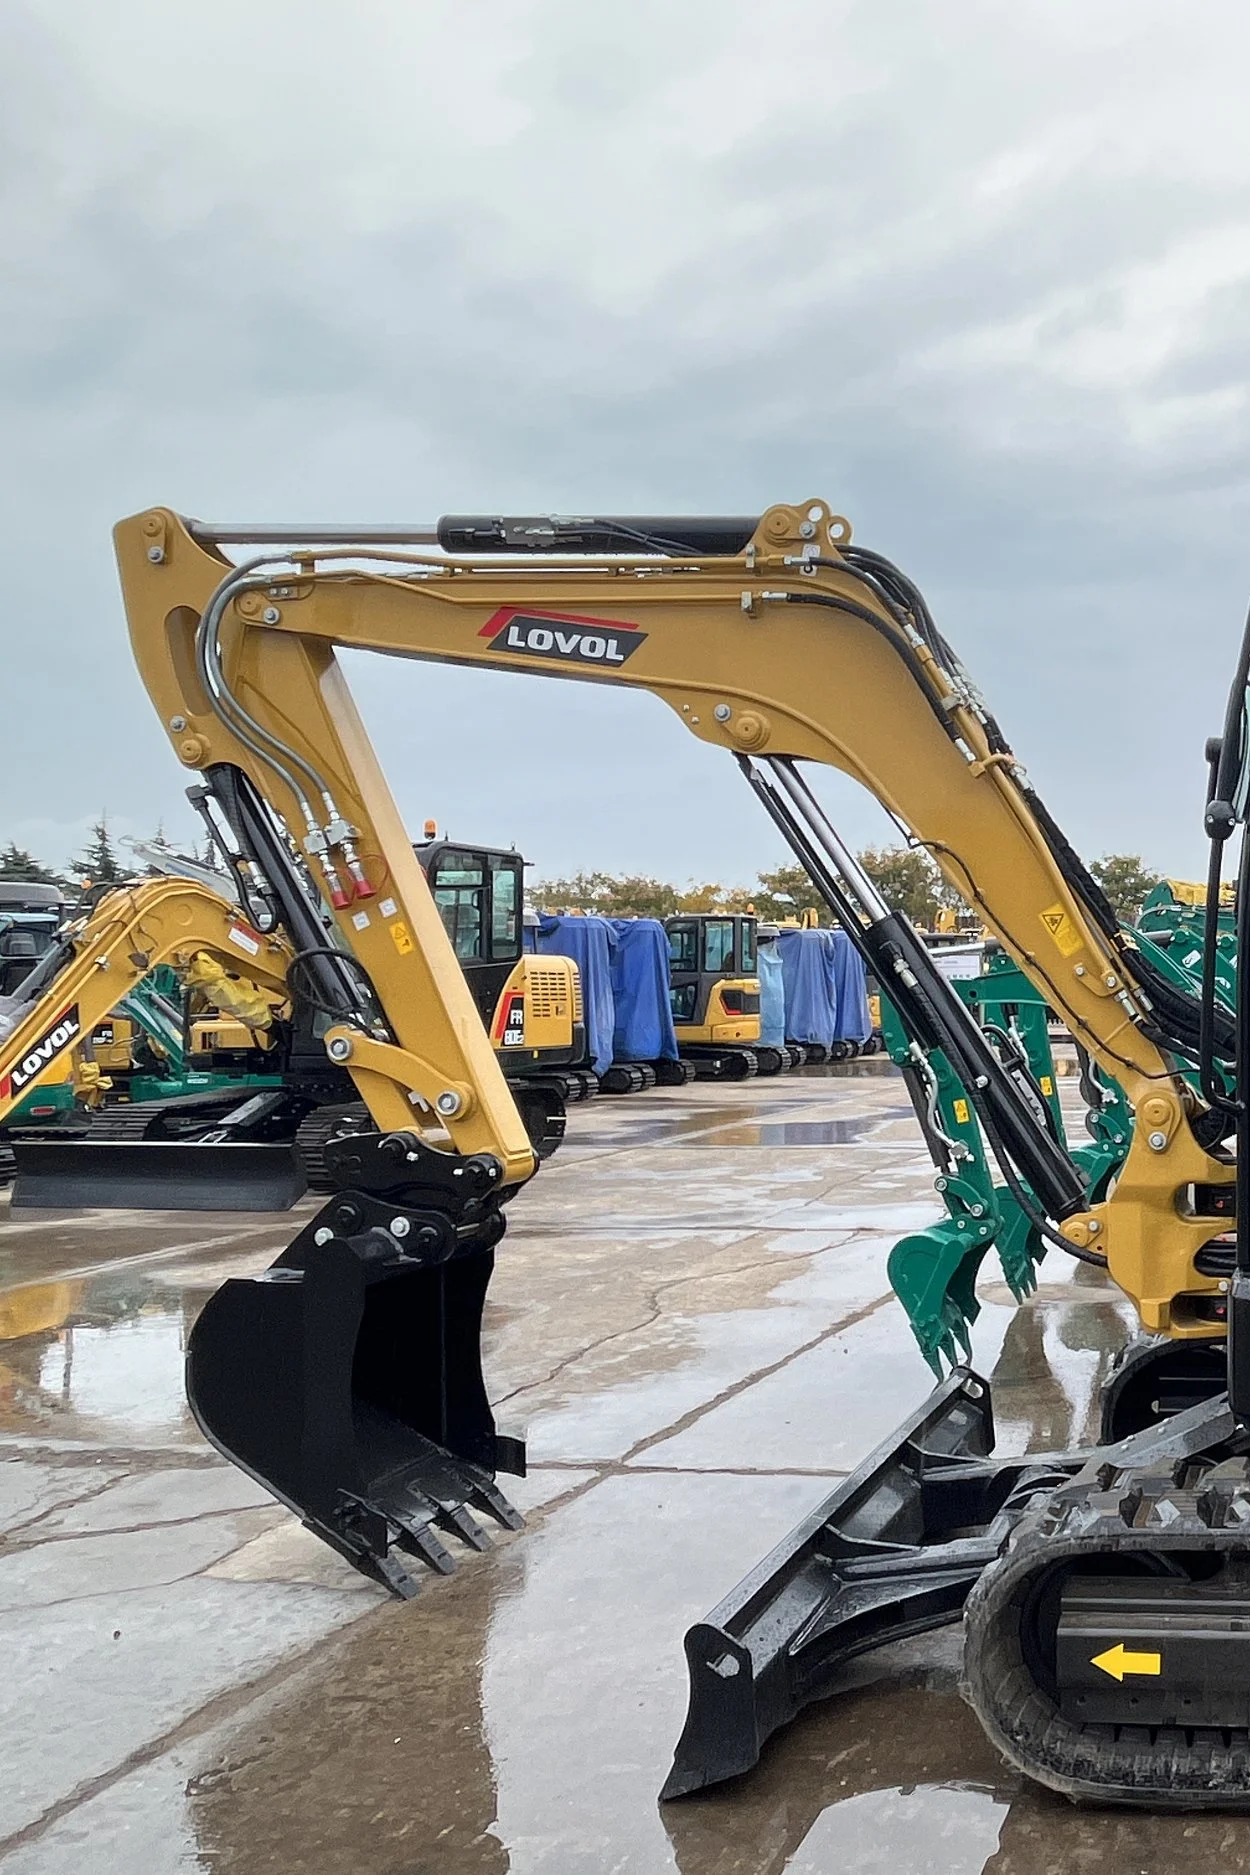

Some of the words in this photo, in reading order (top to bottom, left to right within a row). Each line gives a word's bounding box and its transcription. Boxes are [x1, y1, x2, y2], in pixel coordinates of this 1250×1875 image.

[507, 625, 624, 660] LOVOL
[510, 1009, 523, 1024] FR
[11, 1019, 80, 1086] LOVOL
